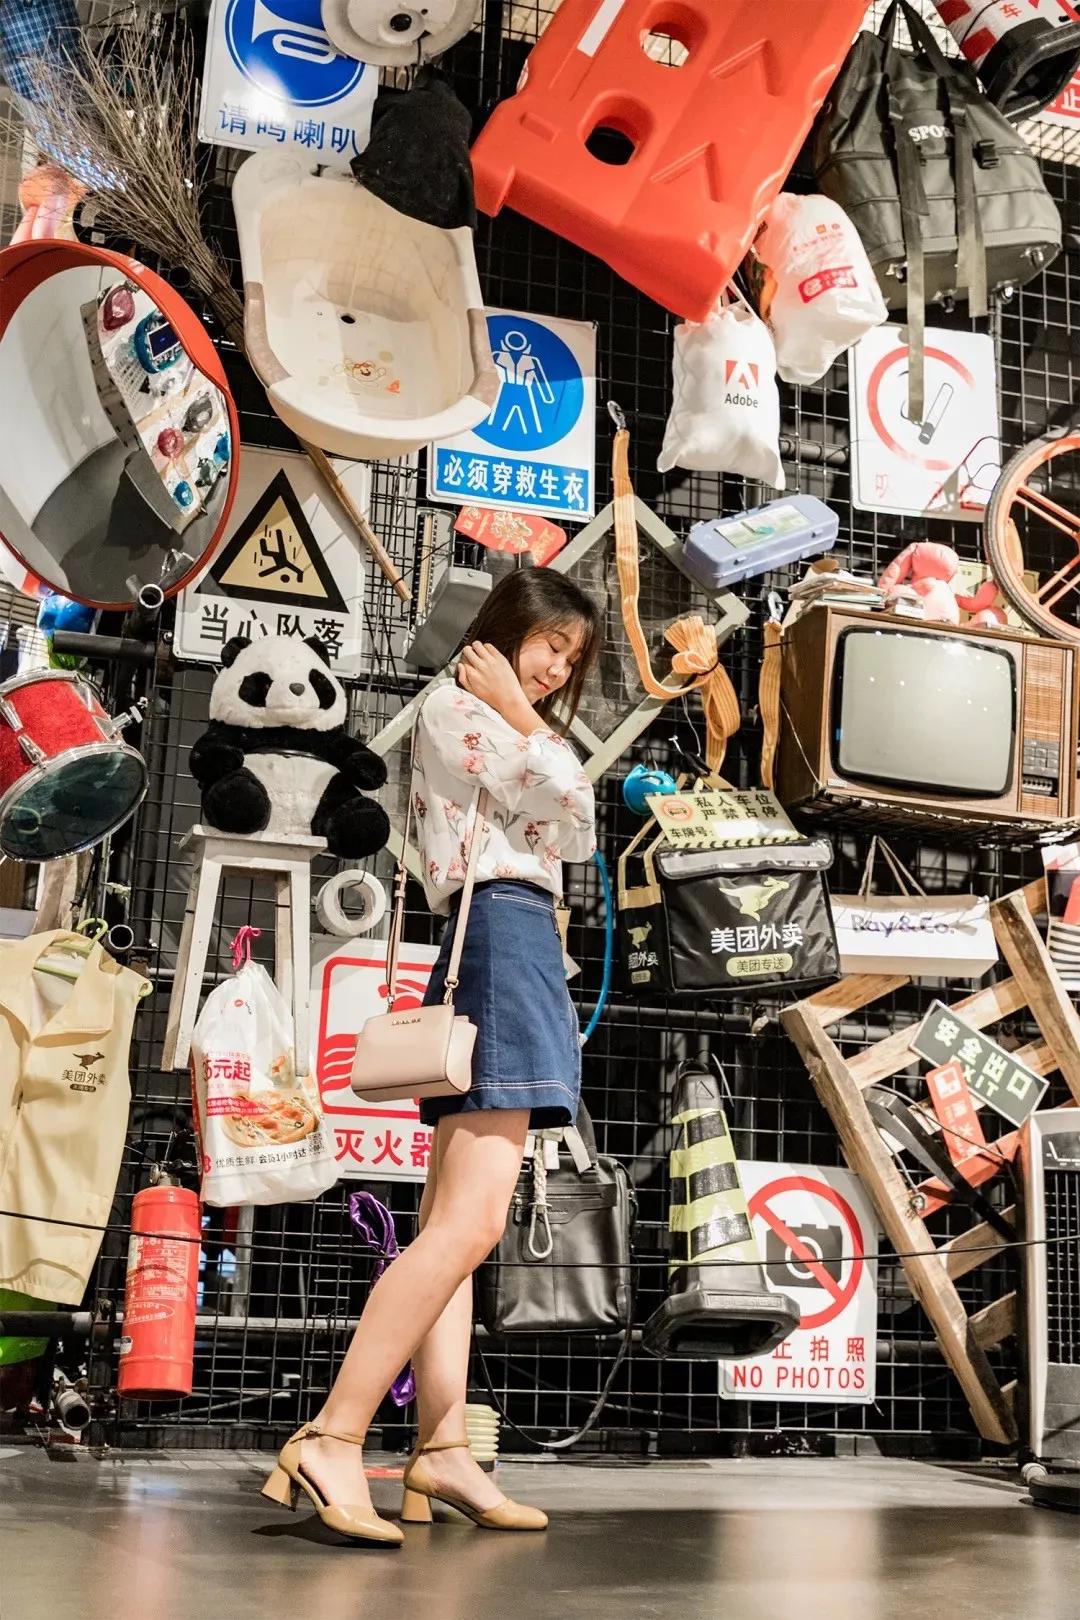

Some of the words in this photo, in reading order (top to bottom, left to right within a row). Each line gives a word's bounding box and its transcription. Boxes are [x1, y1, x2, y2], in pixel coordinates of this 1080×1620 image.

[218, 102, 361, 158] 请鸣喇叭
[724, 393, 759, 408] Adobe
[443, 454, 586, 508] 必须穿救生衣
[694, 793, 772, 809] 私人车位
[701, 805, 779, 821] 严禁占停
[710, 922, 804, 954] 美团外卖
[736, 957, 786, 973] 美团专送
[934, 1017, 1034, 1101] 安全出口
[61, 1069, 106, 1085] 美团外卖
[772, 1335, 865, 1362] 止拍照
[733, 1365, 763, 1388] NO
[776, 1366, 865, 1390] PHOTOS
